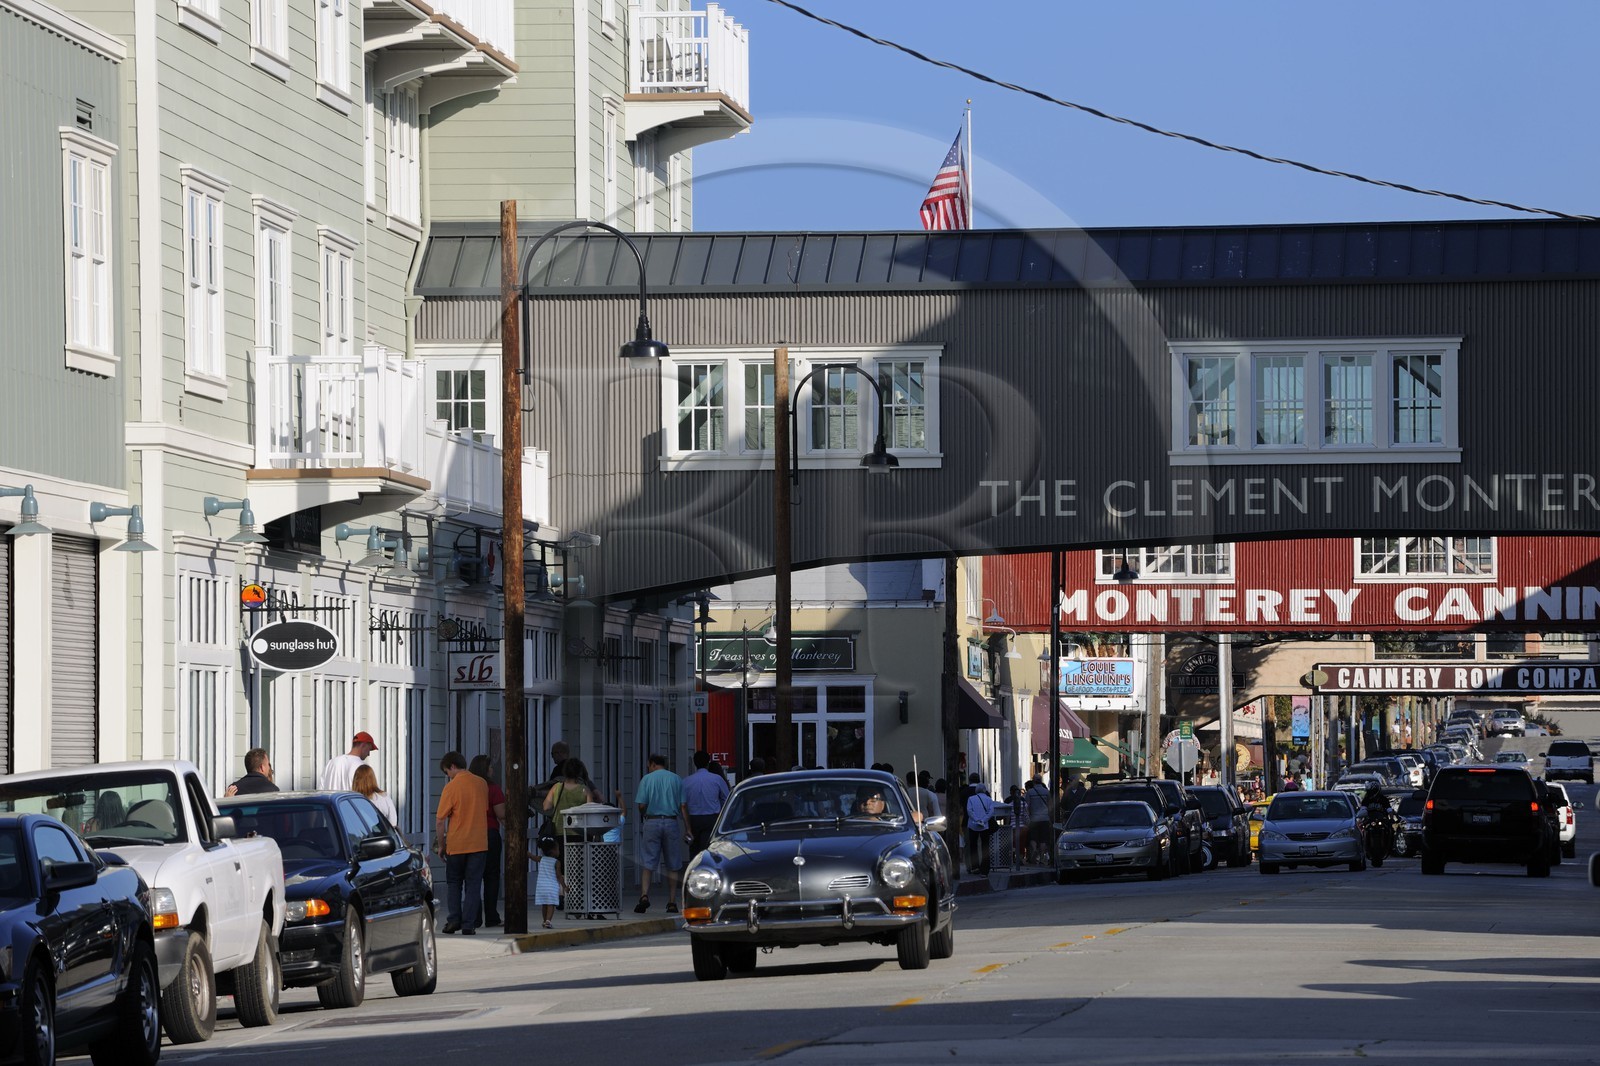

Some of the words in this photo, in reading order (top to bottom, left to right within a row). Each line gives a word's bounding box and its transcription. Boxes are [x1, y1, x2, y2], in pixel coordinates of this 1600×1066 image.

[979, 480, 1077, 518] THE
[1103, 477, 1343, 520] CLEMENT
[1059, 588, 1361, 623] MONTEREY
[270, 639, 314, 653] sunglass
[316, 638, 334, 650] hut
[709, 648, 765, 662] Treasres
[790, 648, 841, 663] Monterey
[1081, 662, 1116, 673] LOUIE
[1178, 676, 1218, 686] MONTEREY
[1338, 668, 1441, 689] CANNERY
[1455, 668, 1502, 689] ROW
[1517, 668, 1597, 689] COMPA
